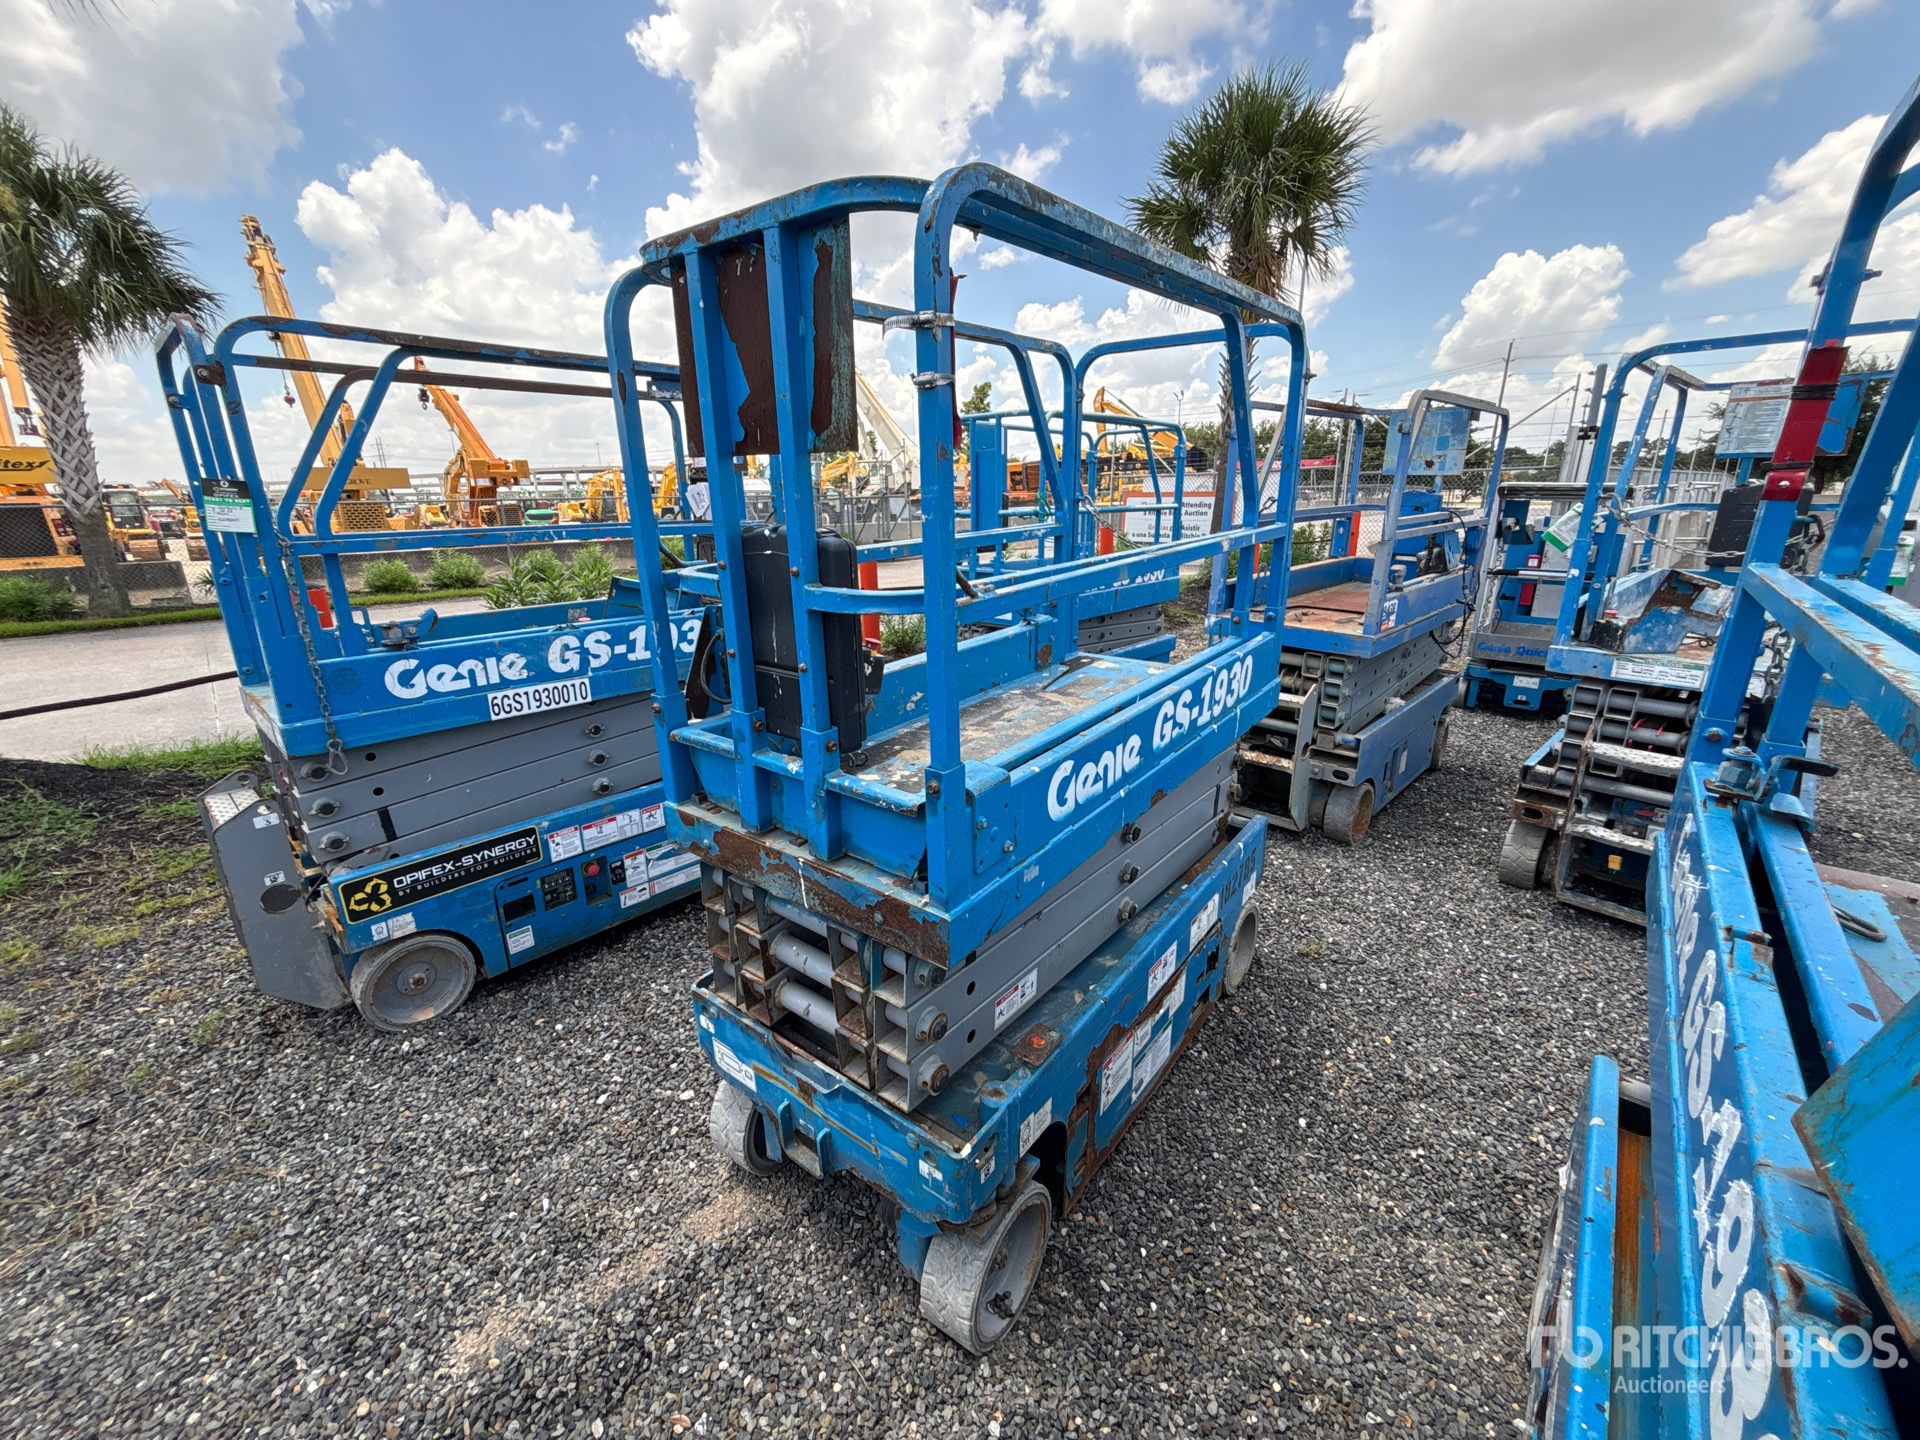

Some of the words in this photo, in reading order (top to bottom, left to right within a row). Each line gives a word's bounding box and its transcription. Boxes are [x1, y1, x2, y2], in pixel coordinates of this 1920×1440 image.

[384, 652, 528, 699] Genie
[490, 680, 589, 717] 6GS1930010
[1047, 734, 1142, 822] Genie
[1153, 655, 1254, 753] GS-1930
[393, 834, 536, 889] OPIFEX-SYNERGY
[398, 888, 411, 897] BY
[417, 869, 466, 891] BUILDERS
[470, 862, 489, 874] FOR
[493, 847, 537, 866] BUILDERS
